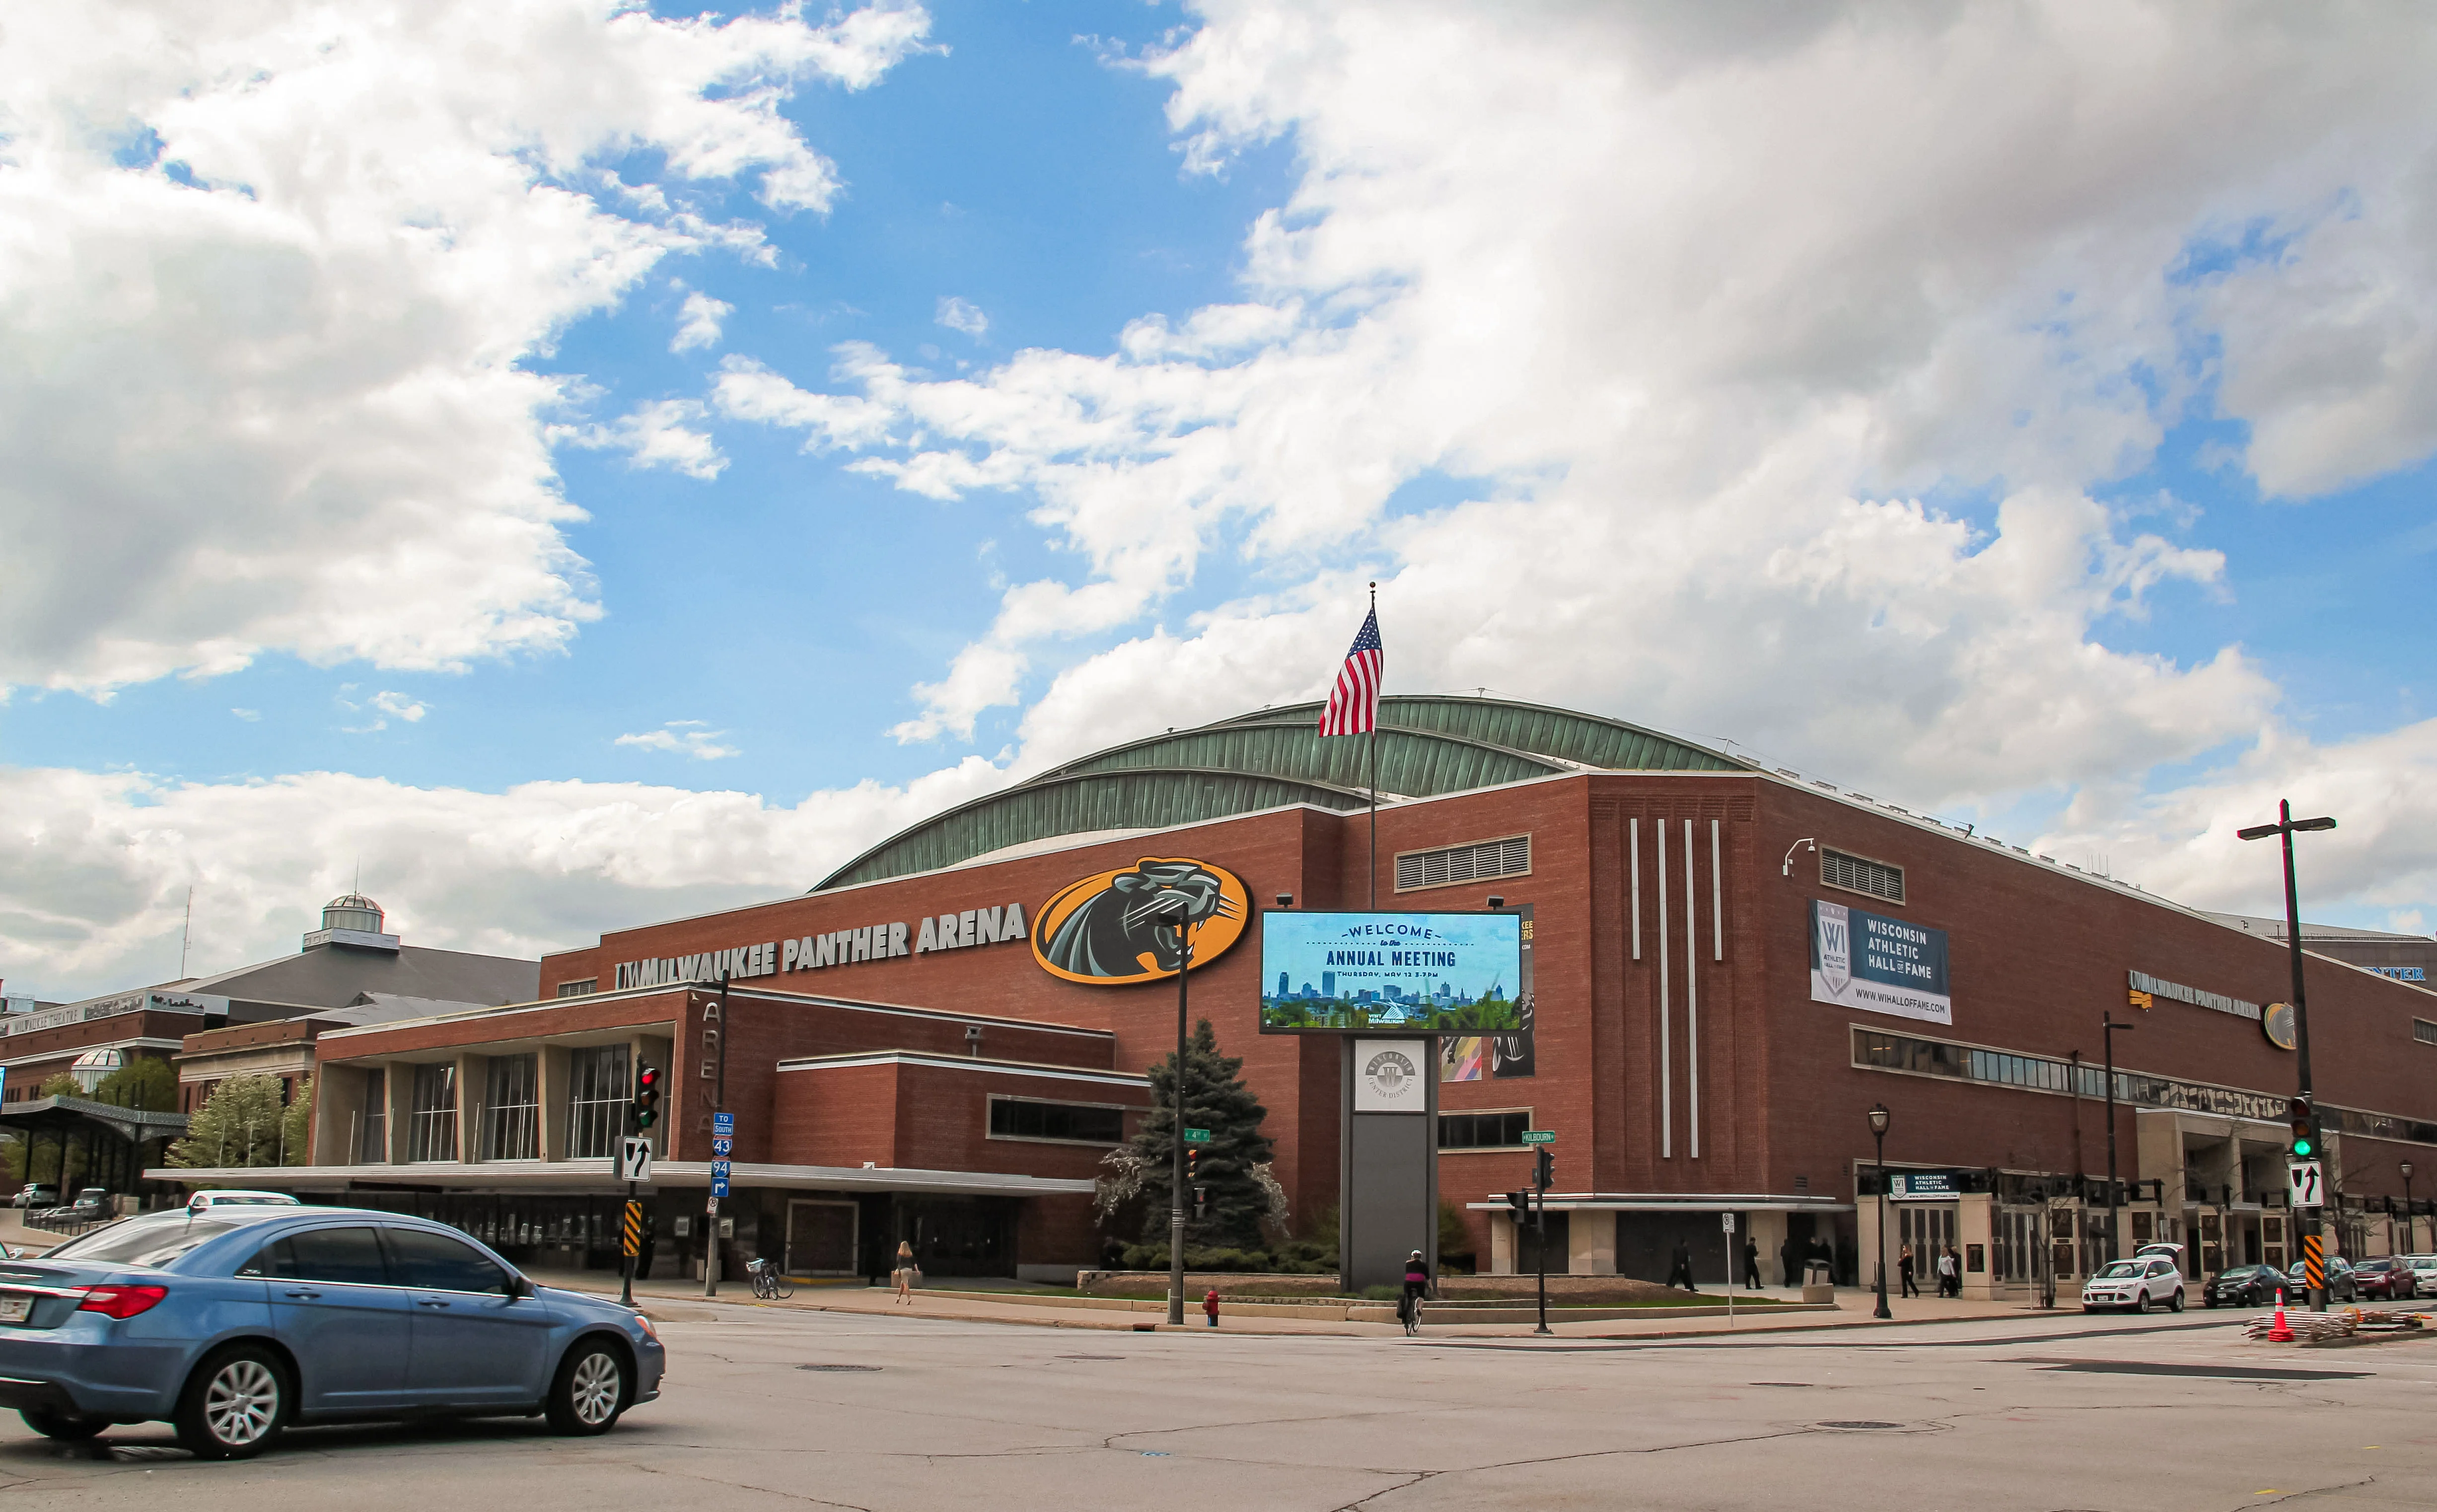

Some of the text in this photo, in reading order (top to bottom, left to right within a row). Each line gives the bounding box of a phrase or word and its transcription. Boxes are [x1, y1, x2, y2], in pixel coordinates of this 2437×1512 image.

[782, 922, 910, 972] PANTHER
[915, 903, 1027, 953] ARENA
[1349, 924, 1433, 939] WELCOME
[1867, 919, 1927, 945] WISCONSIN
[1868, 937, 1919, 959] ATHLETIC
[1326, 950, 1456, 967] ANNUAL MEETING
[1824, 954, 1845, 963] ATHLETIC
[1868, 954, 1932, 979] HALL OF FAME
[1856, 988, 1945, 1014] WWW.WIHALLOFFAME.COM
[15, 1009, 77, 1032] MILWAUKEE THEATRE
[1369, 1053, 1413, 1071] WISCONSIN
[1368, 1077, 1413, 1098] CENTER DISTRICT
[715, 1125, 731, 1134] SOUTH
[715, 1140, 729, 1152] 43
[714, 1162, 727, 1173] 94
